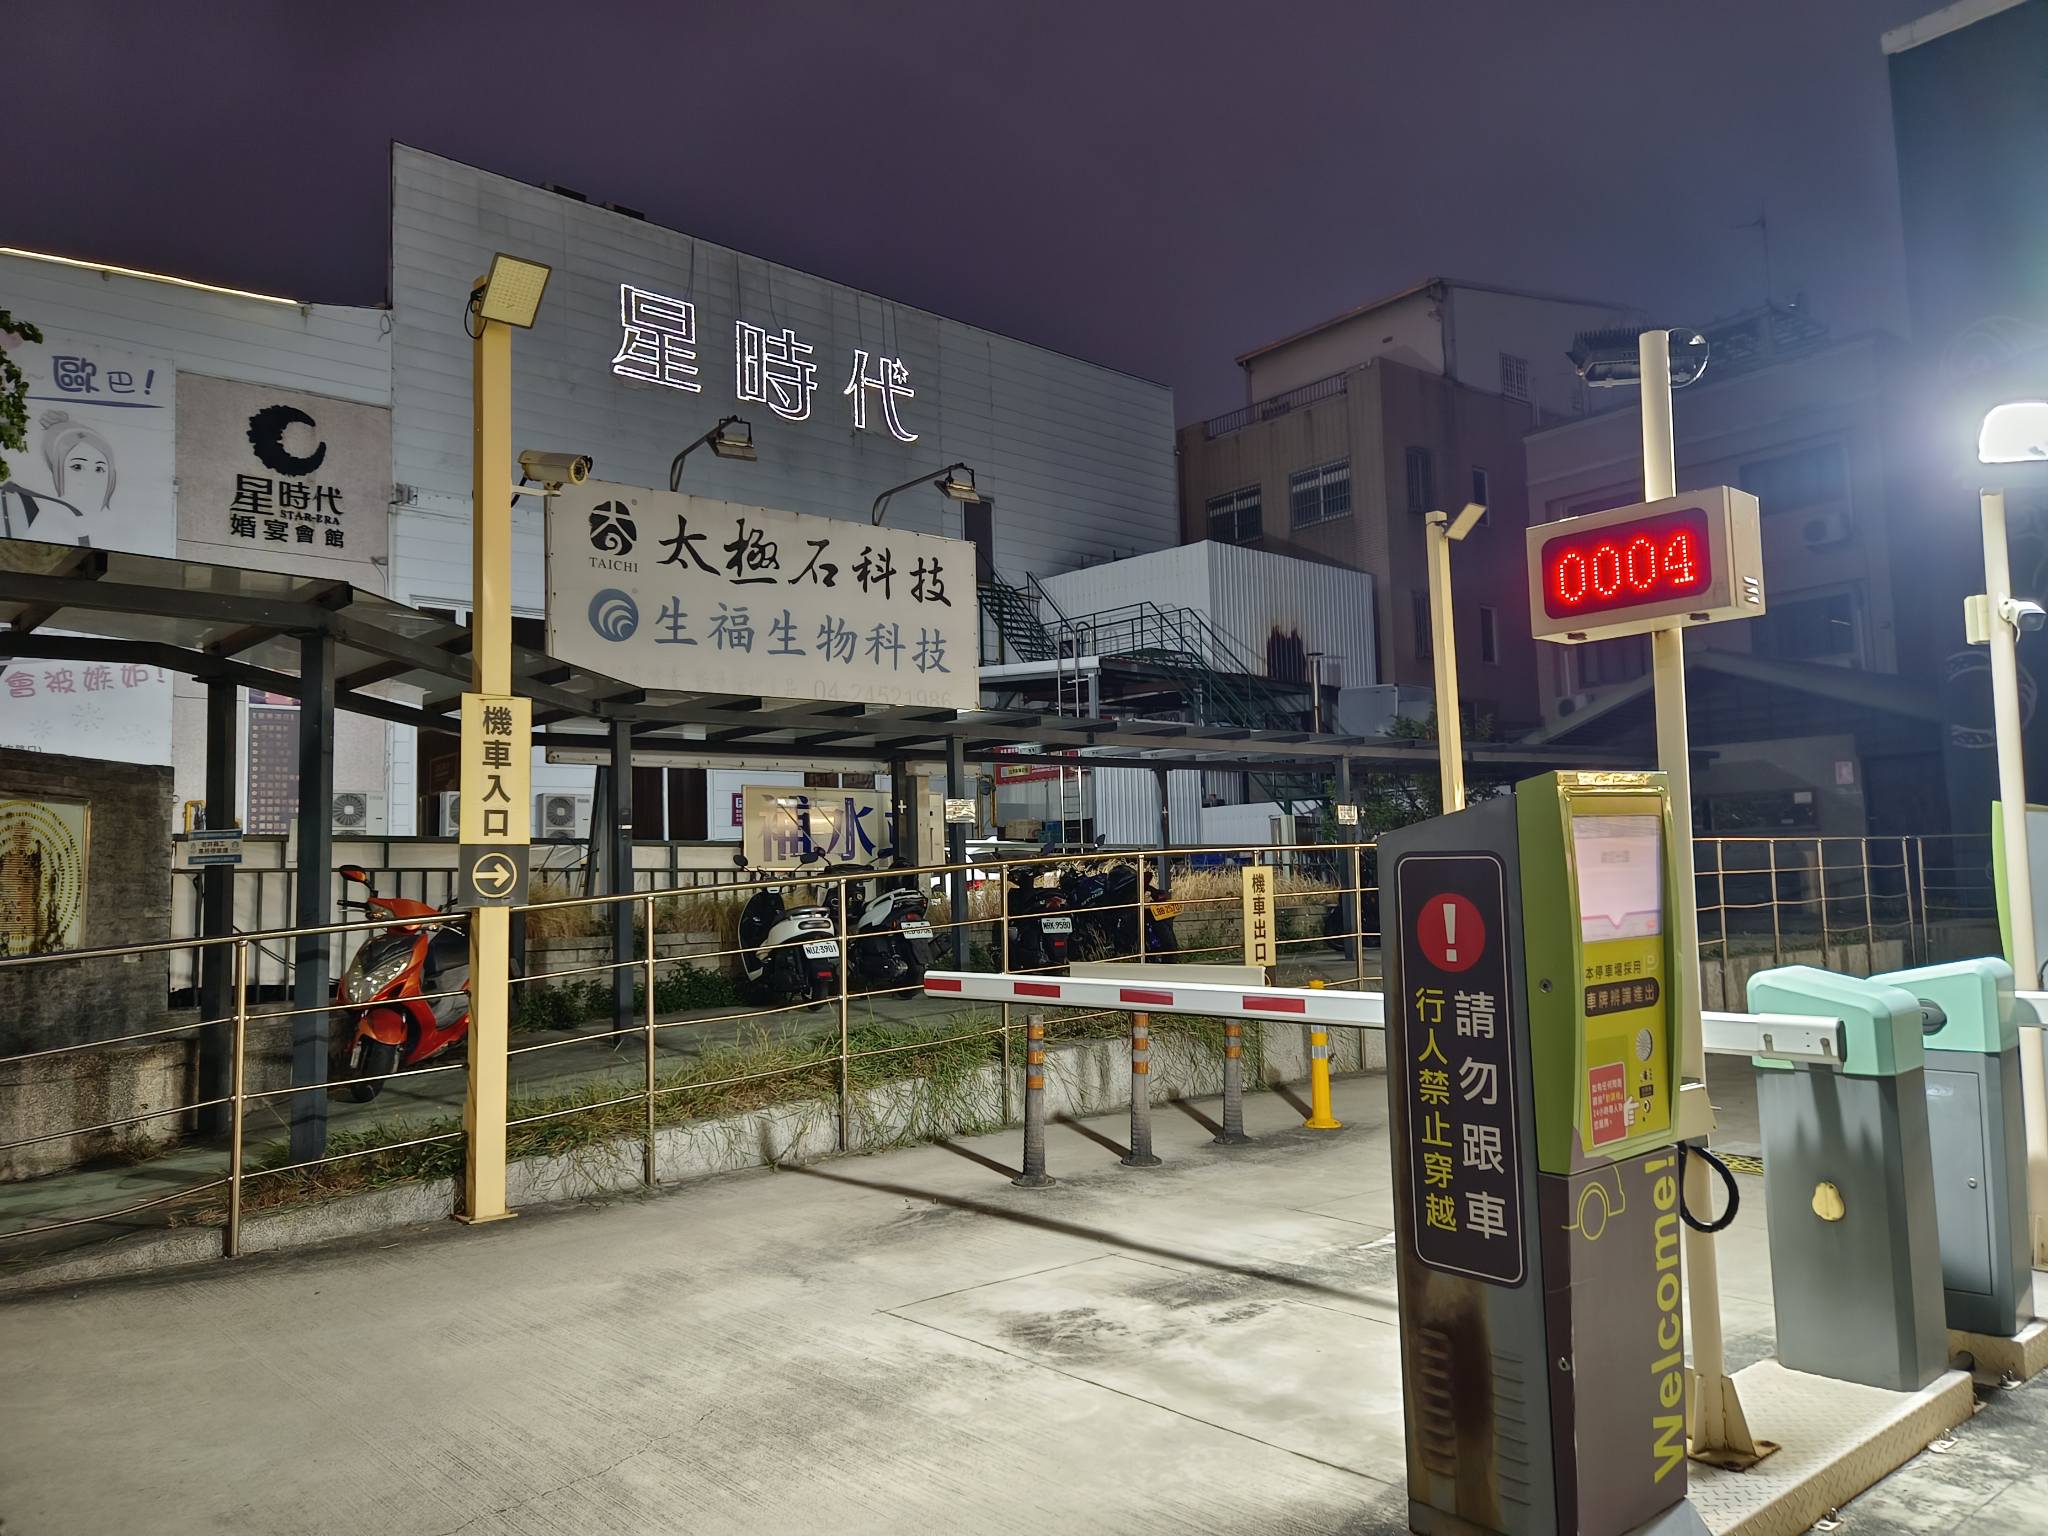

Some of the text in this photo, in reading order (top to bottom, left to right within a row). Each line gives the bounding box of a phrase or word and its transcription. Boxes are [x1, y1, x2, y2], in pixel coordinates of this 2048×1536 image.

[52, 356, 155, 395] 歐巴!
[612, 284, 919, 443] 星時代
[229, 513, 344, 549] 婚宴會館
[230, 473, 344, 515] 星時代
[280, 509, 340, 526] STAR-ERA
[589, 556, 638, 573] TAICHI
[656, 514, 951, 607] 太極石科技
[1558, 534, 1697, 602] 0004
[654, 596, 951, 674] 生福生物科技
[482, 706, 512, 837] 機車入口
[1252, 873, 1266, 962] 機車出口
[1415, 987, 1457, 1232] 行人禁止穿越
[1454, 990, 1508, 1239] 請勿跟車
[1645, 1155, 1684, 1484] Welcome!
